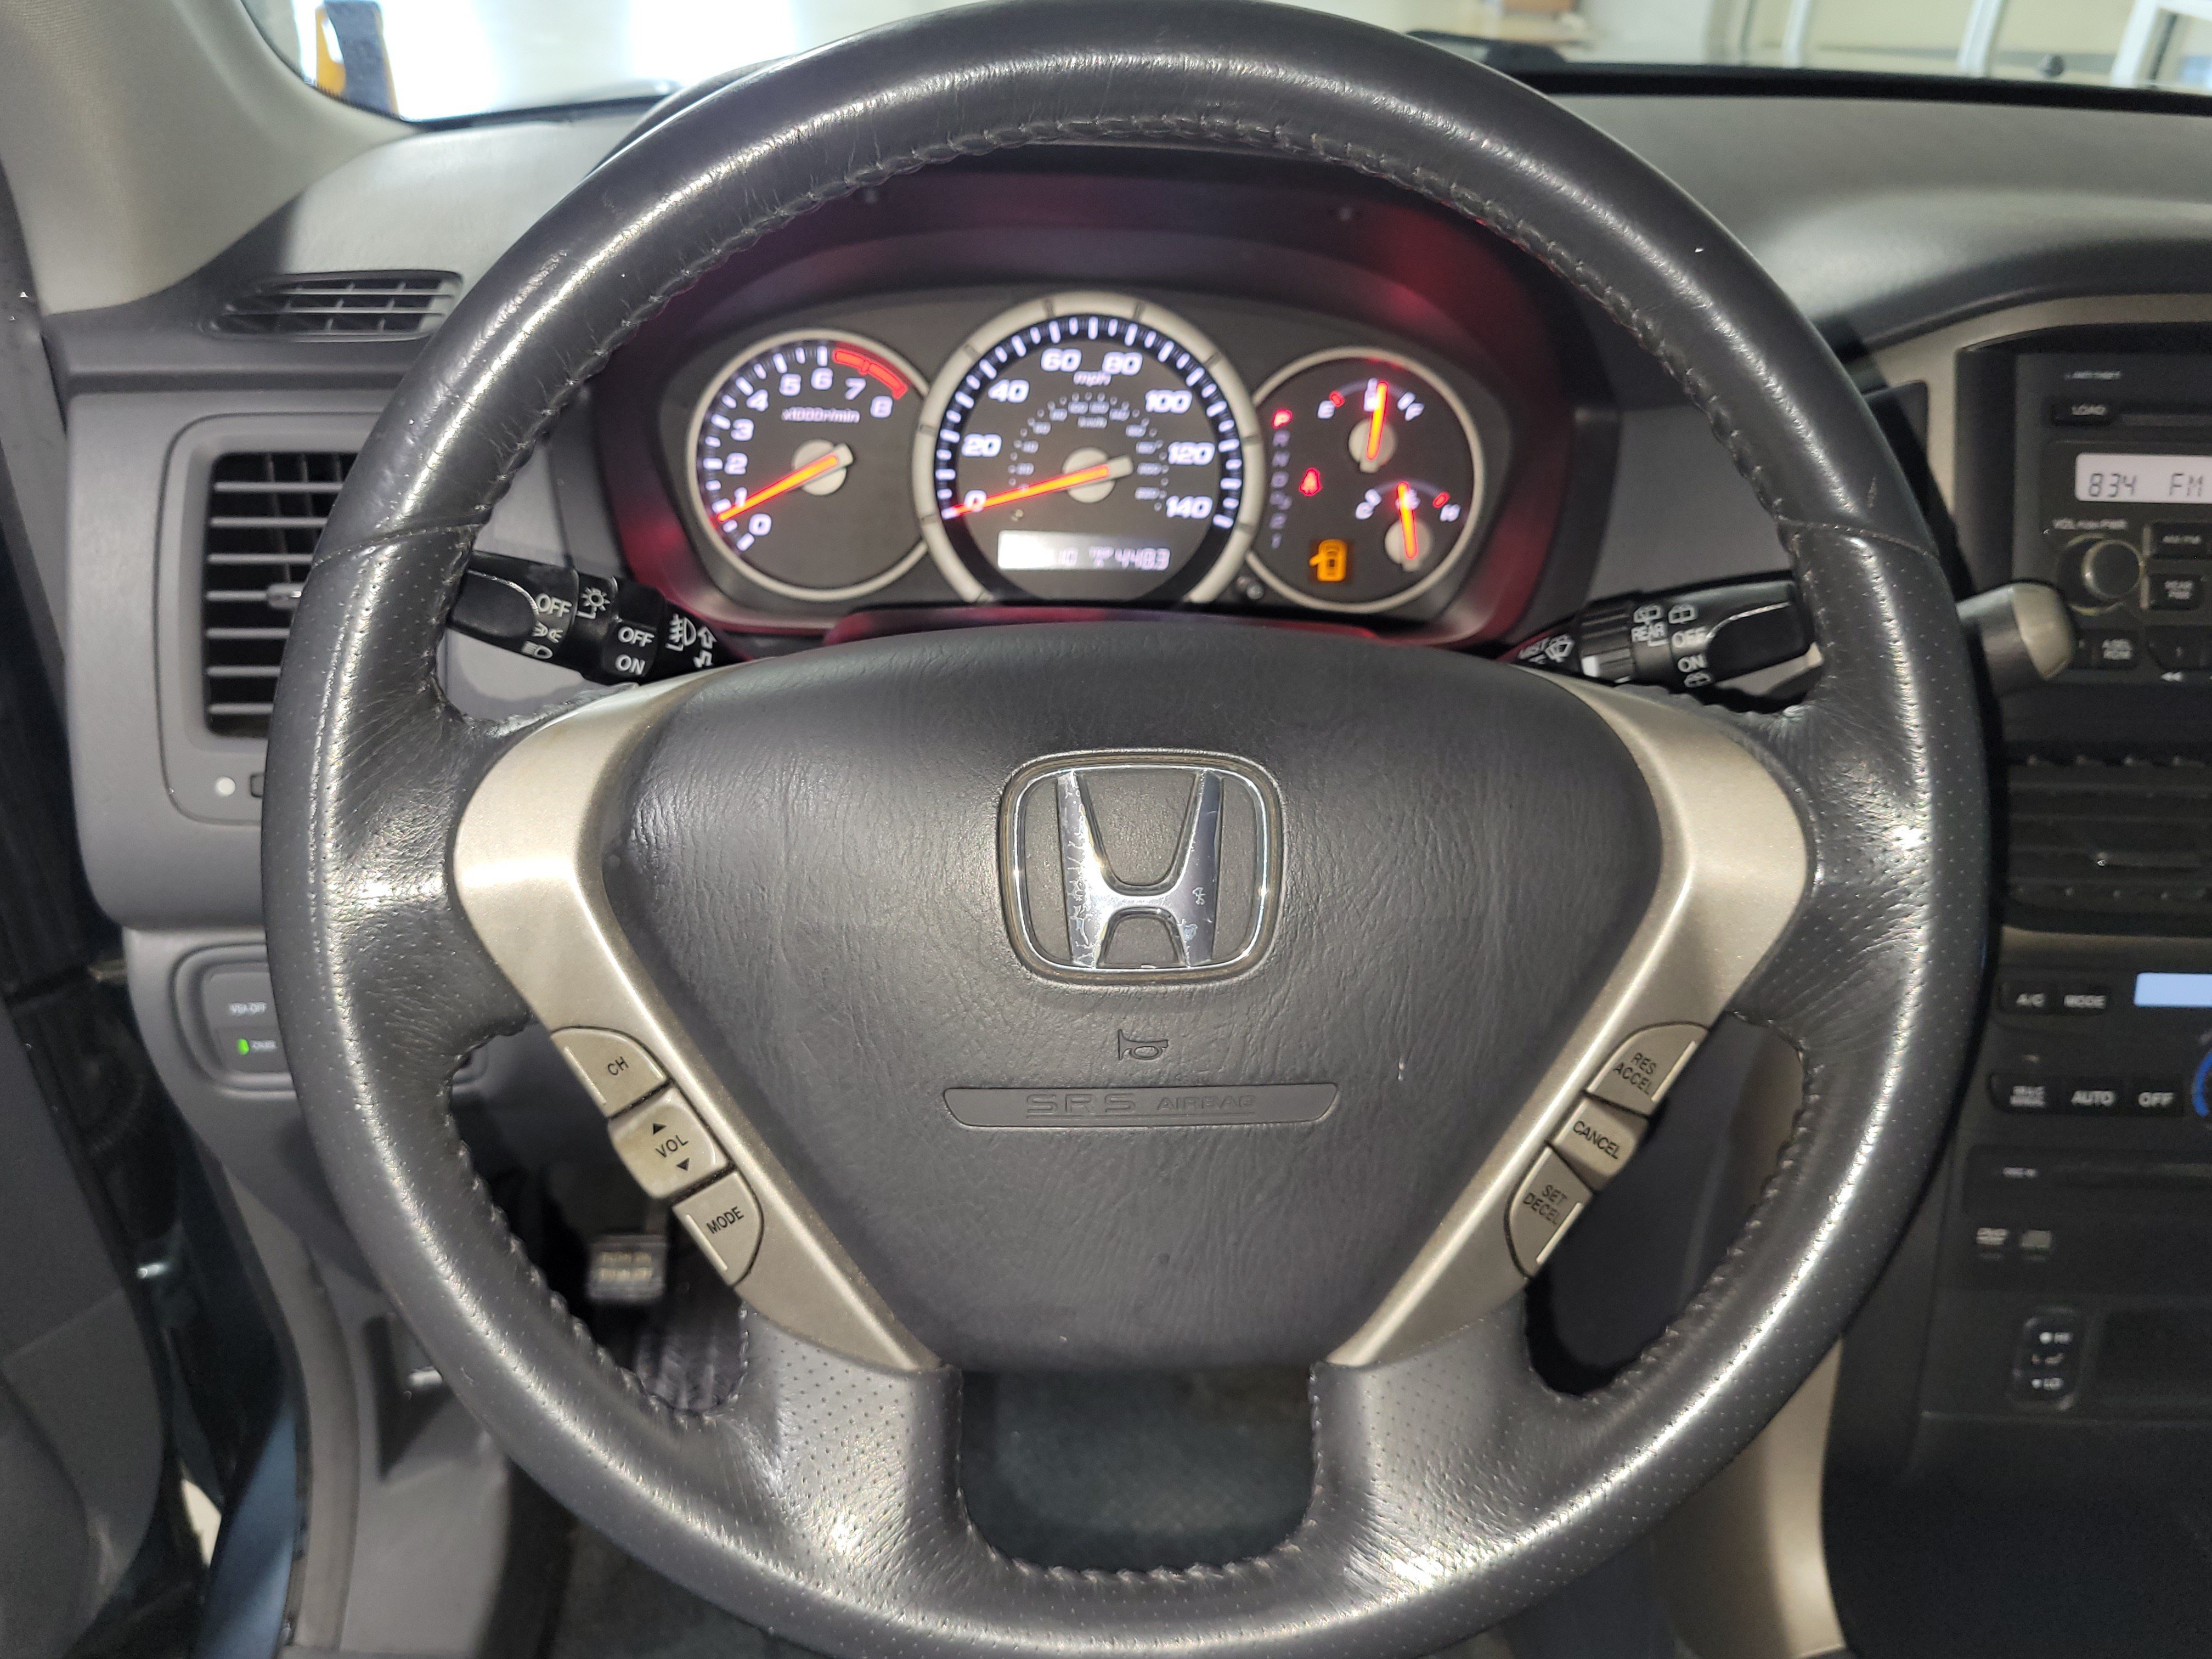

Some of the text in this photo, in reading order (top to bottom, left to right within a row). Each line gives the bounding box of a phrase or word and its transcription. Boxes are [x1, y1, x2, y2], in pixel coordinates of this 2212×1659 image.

[1041, 348, 1081, 372] 60
[1102, 352, 1143, 375] 80
[779, 374, 802, 396] 5
[811, 368, 833, 390] 6
[845, 377, 866, 400] 7
[1073, 371, 1111, 386] mph
[747, 389, 769, 411] 4
[988, 380, 1029, 403] 40
[1145, 390, 1192, 414] 100
[871, 395, 893, 418] 8
[731, 419, 754, 441] 3
[961, 434, 1002, 458] 20
[1168, 442, 1215, 465] 120
[725, 453, 748, 475] 2
[2169, 472, 2203, 497] FM
[734, 487, 747, 507] 1
[964, 490, 986, 513] 0
[1166, 496, 1213, 519] 140
[749, 514, 772, 535] 0
[535, 593, 573, 618] OFF
[618, 626, 655, 647] OFF
[1631, 621, 1667, 643] REAR
[1672, 626, 1708, 649] OFF
[615, 654, 646, 675] ON
[1678, 653, 1707, 673] ON
[607, 1056, 629, 1076] CH
[1631, 1052, 1657, 1075] RES
[1612, 1062, 1653, 1095] ACCEL
[1026, 1093, 1136, 1115] SRS
[2070, 1090, 2115, 1107] AUTO
[2139, 1092, 2174, 1108] OFF
[655, 1135, 689, 1158] VOL
[1573, 1120, 1619, 1159] CANCEL
[1542, 1184, 1567, 1205] SET
[706, 1206, 744, 1234] MODE
[1523, 1192, 1560, 1225] DECEL
